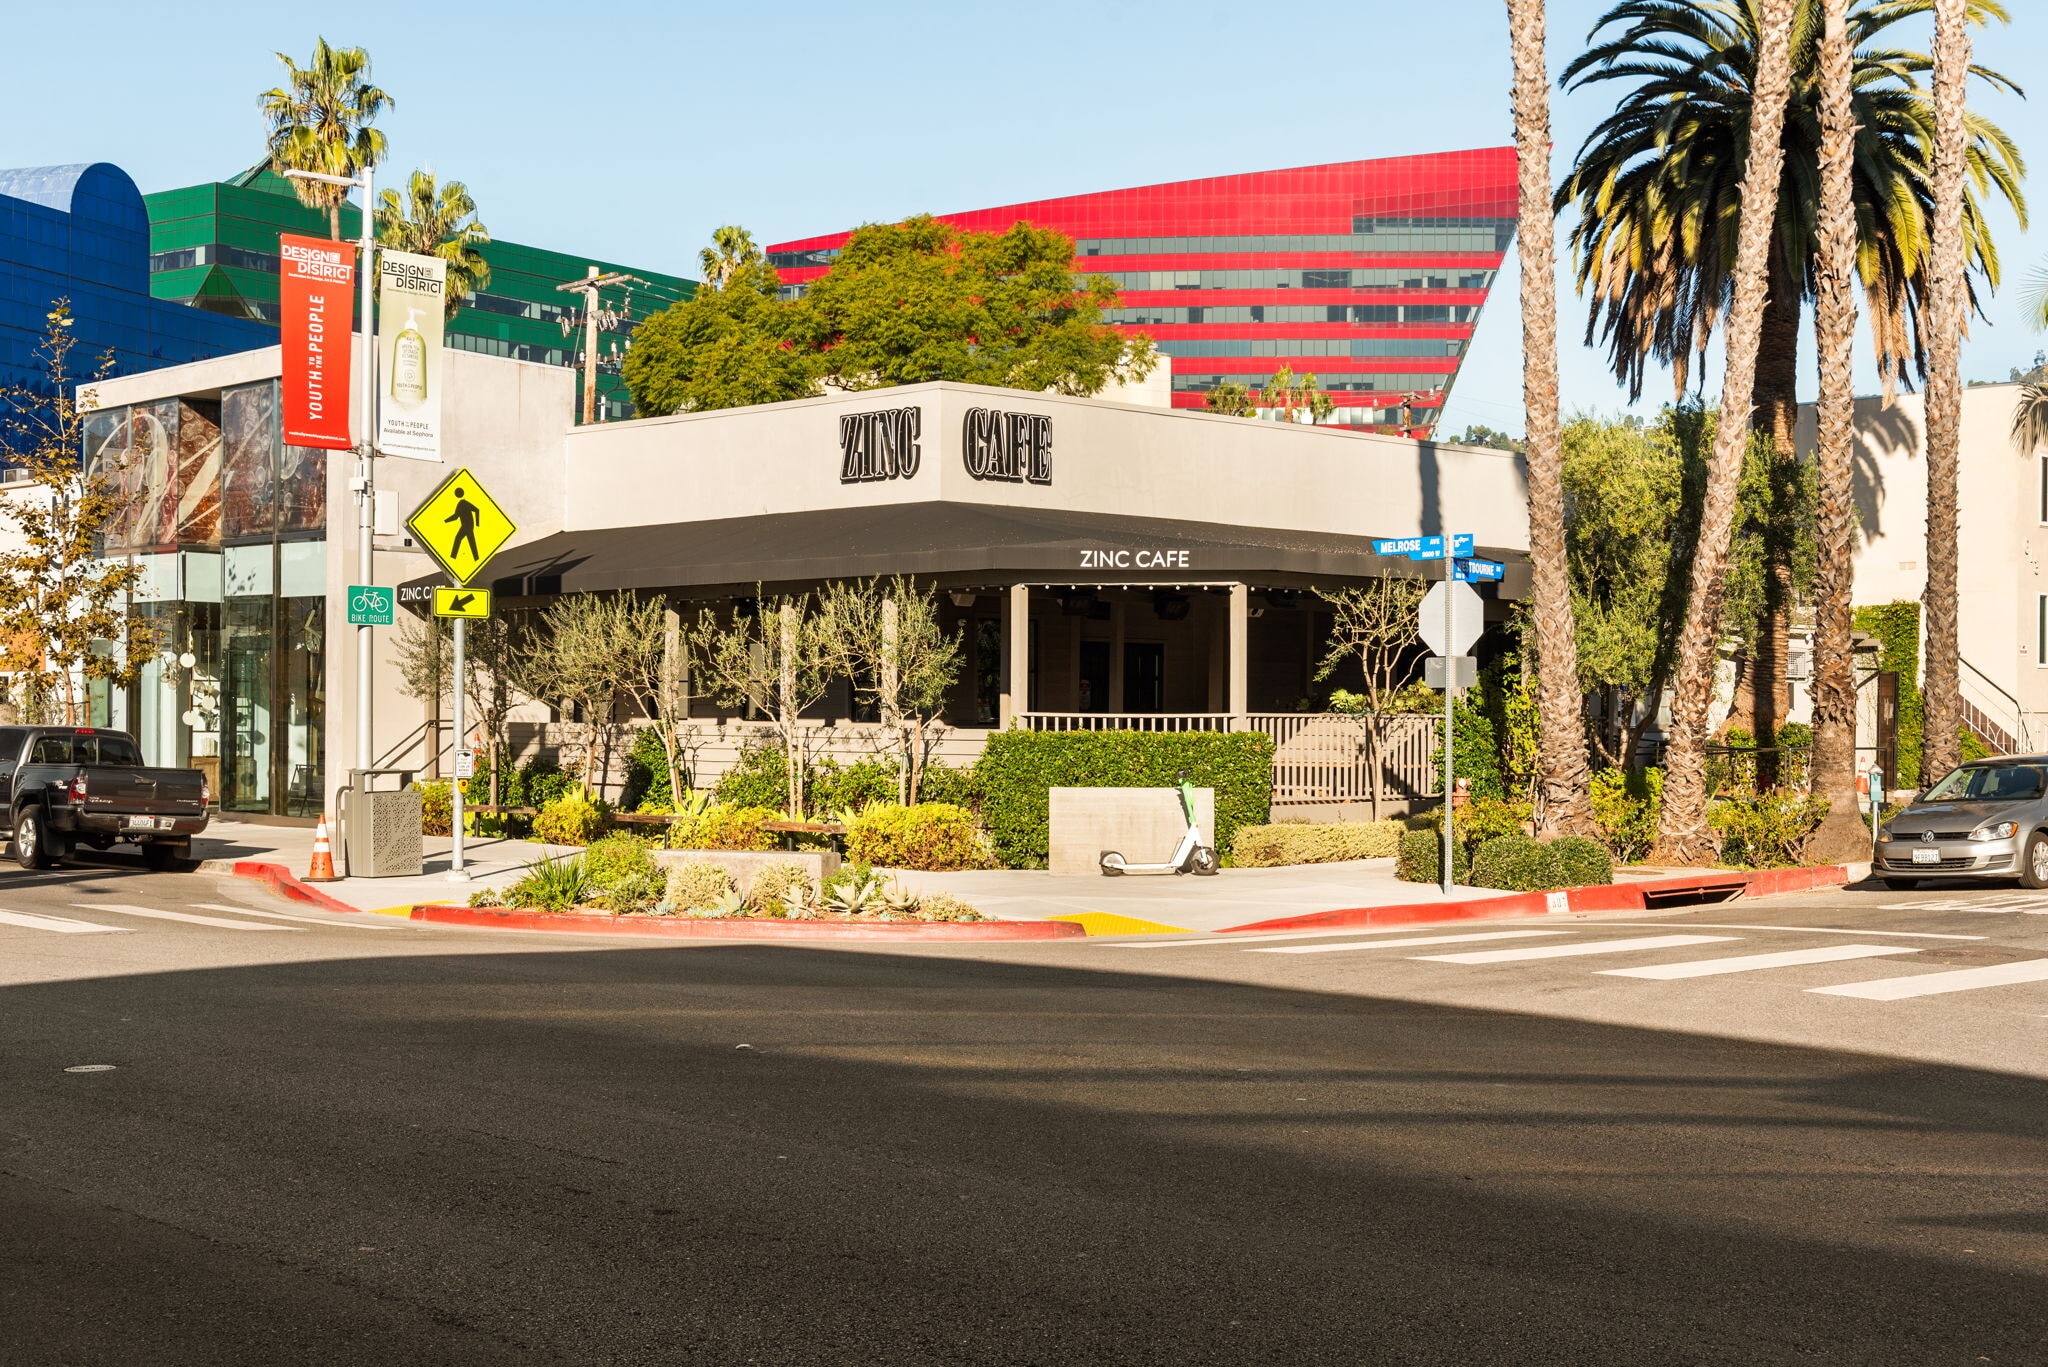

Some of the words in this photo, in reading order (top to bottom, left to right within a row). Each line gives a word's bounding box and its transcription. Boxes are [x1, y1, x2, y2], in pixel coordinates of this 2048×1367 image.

[282, 245, 329, 262] DESIGN
[298, 262, 352, 279] DISTRICT
[383, 261, 424, 276] DESIGN
[396, 277, 442, 293] DISTRICT
[309, 295, 325, 353] PEOPLE
[308, 371, 323, 420] YOUTH
[839, 406, 921, 485] ZINC
[962, 407, 1053, 486] CAFE
[1380, 540, 1421, 554] MELROSE
[1080, 550, 1130, 568] ZINC
[1135, 550, 1190, 568] CAFE
[401, 586, 422, 601] ZINC
[351, 613, 366, 622] BIKE
[369, 614, 390, 623] ROUTE
